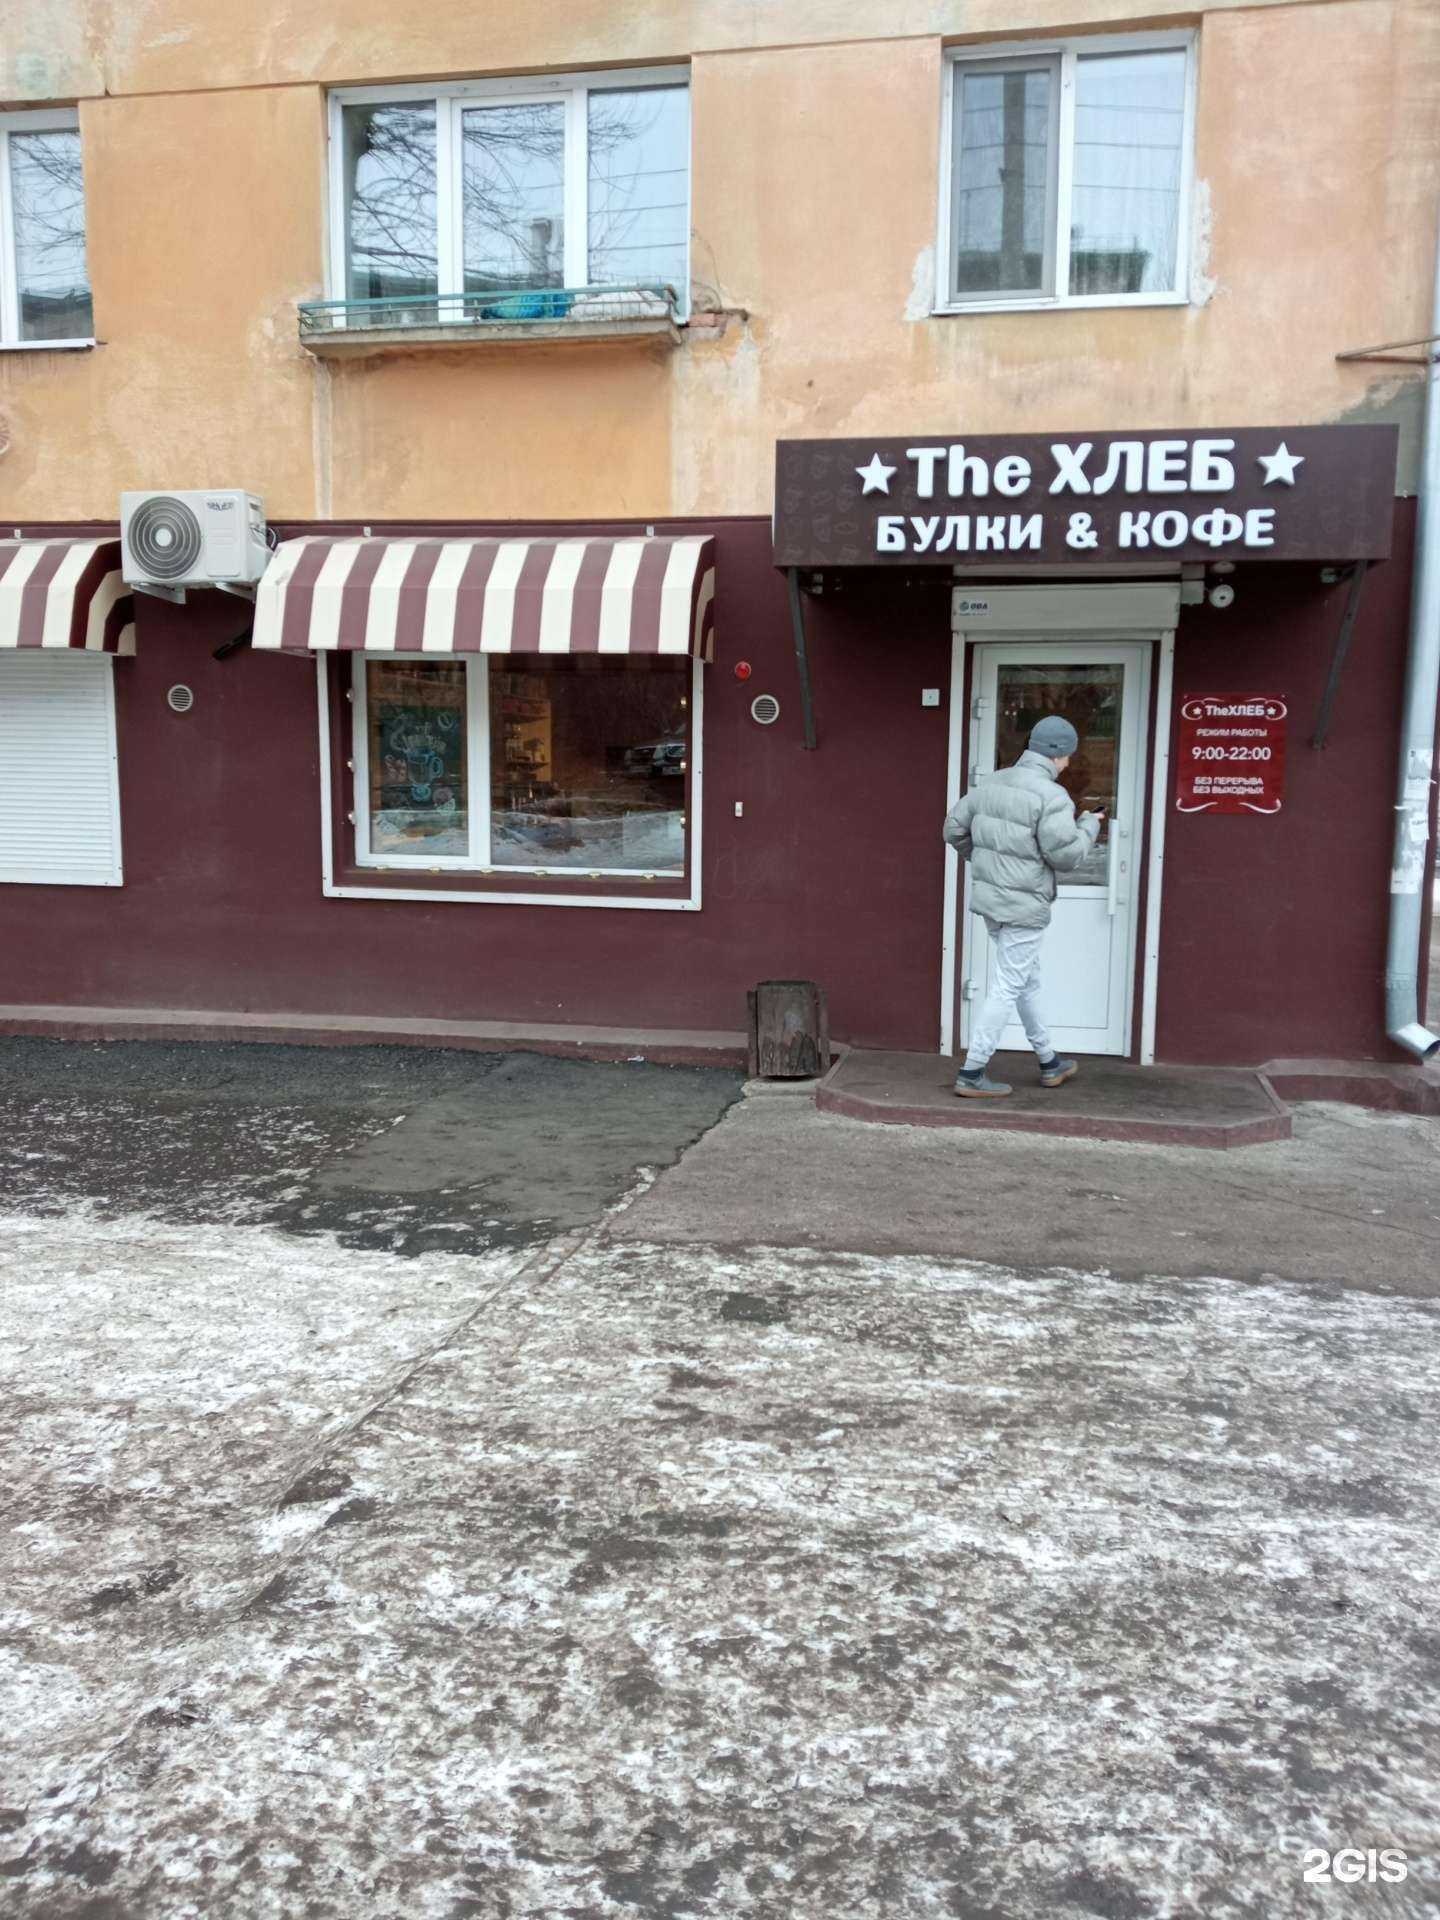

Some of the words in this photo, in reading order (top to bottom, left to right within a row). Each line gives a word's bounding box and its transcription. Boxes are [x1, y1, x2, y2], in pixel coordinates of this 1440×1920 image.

[905, 444, 1032, 498] The
[1048, 438, 1236, 496] ХЛЕБ
[876, 512, 1043, 553] БУЛКИ
[1065, 511, 1099, 549] &
[1118, 507, 1276, 549] КОФЕ
[1196, 728, 1230, 737] РЕЖИМ
[1231, 728, 1268, 737] РАБОТЫ
[1192, 746, 1272, 760] 9:00-22:00
[1194, 776, 1213, 785] БЕЗ
[1213, 776, 1264, 785] ПЕРЕРЫВА
[1192, 785, 1211, 794] БЕЗ
[1211, 785, 1265, 795] ВЫХОДНЫХ
